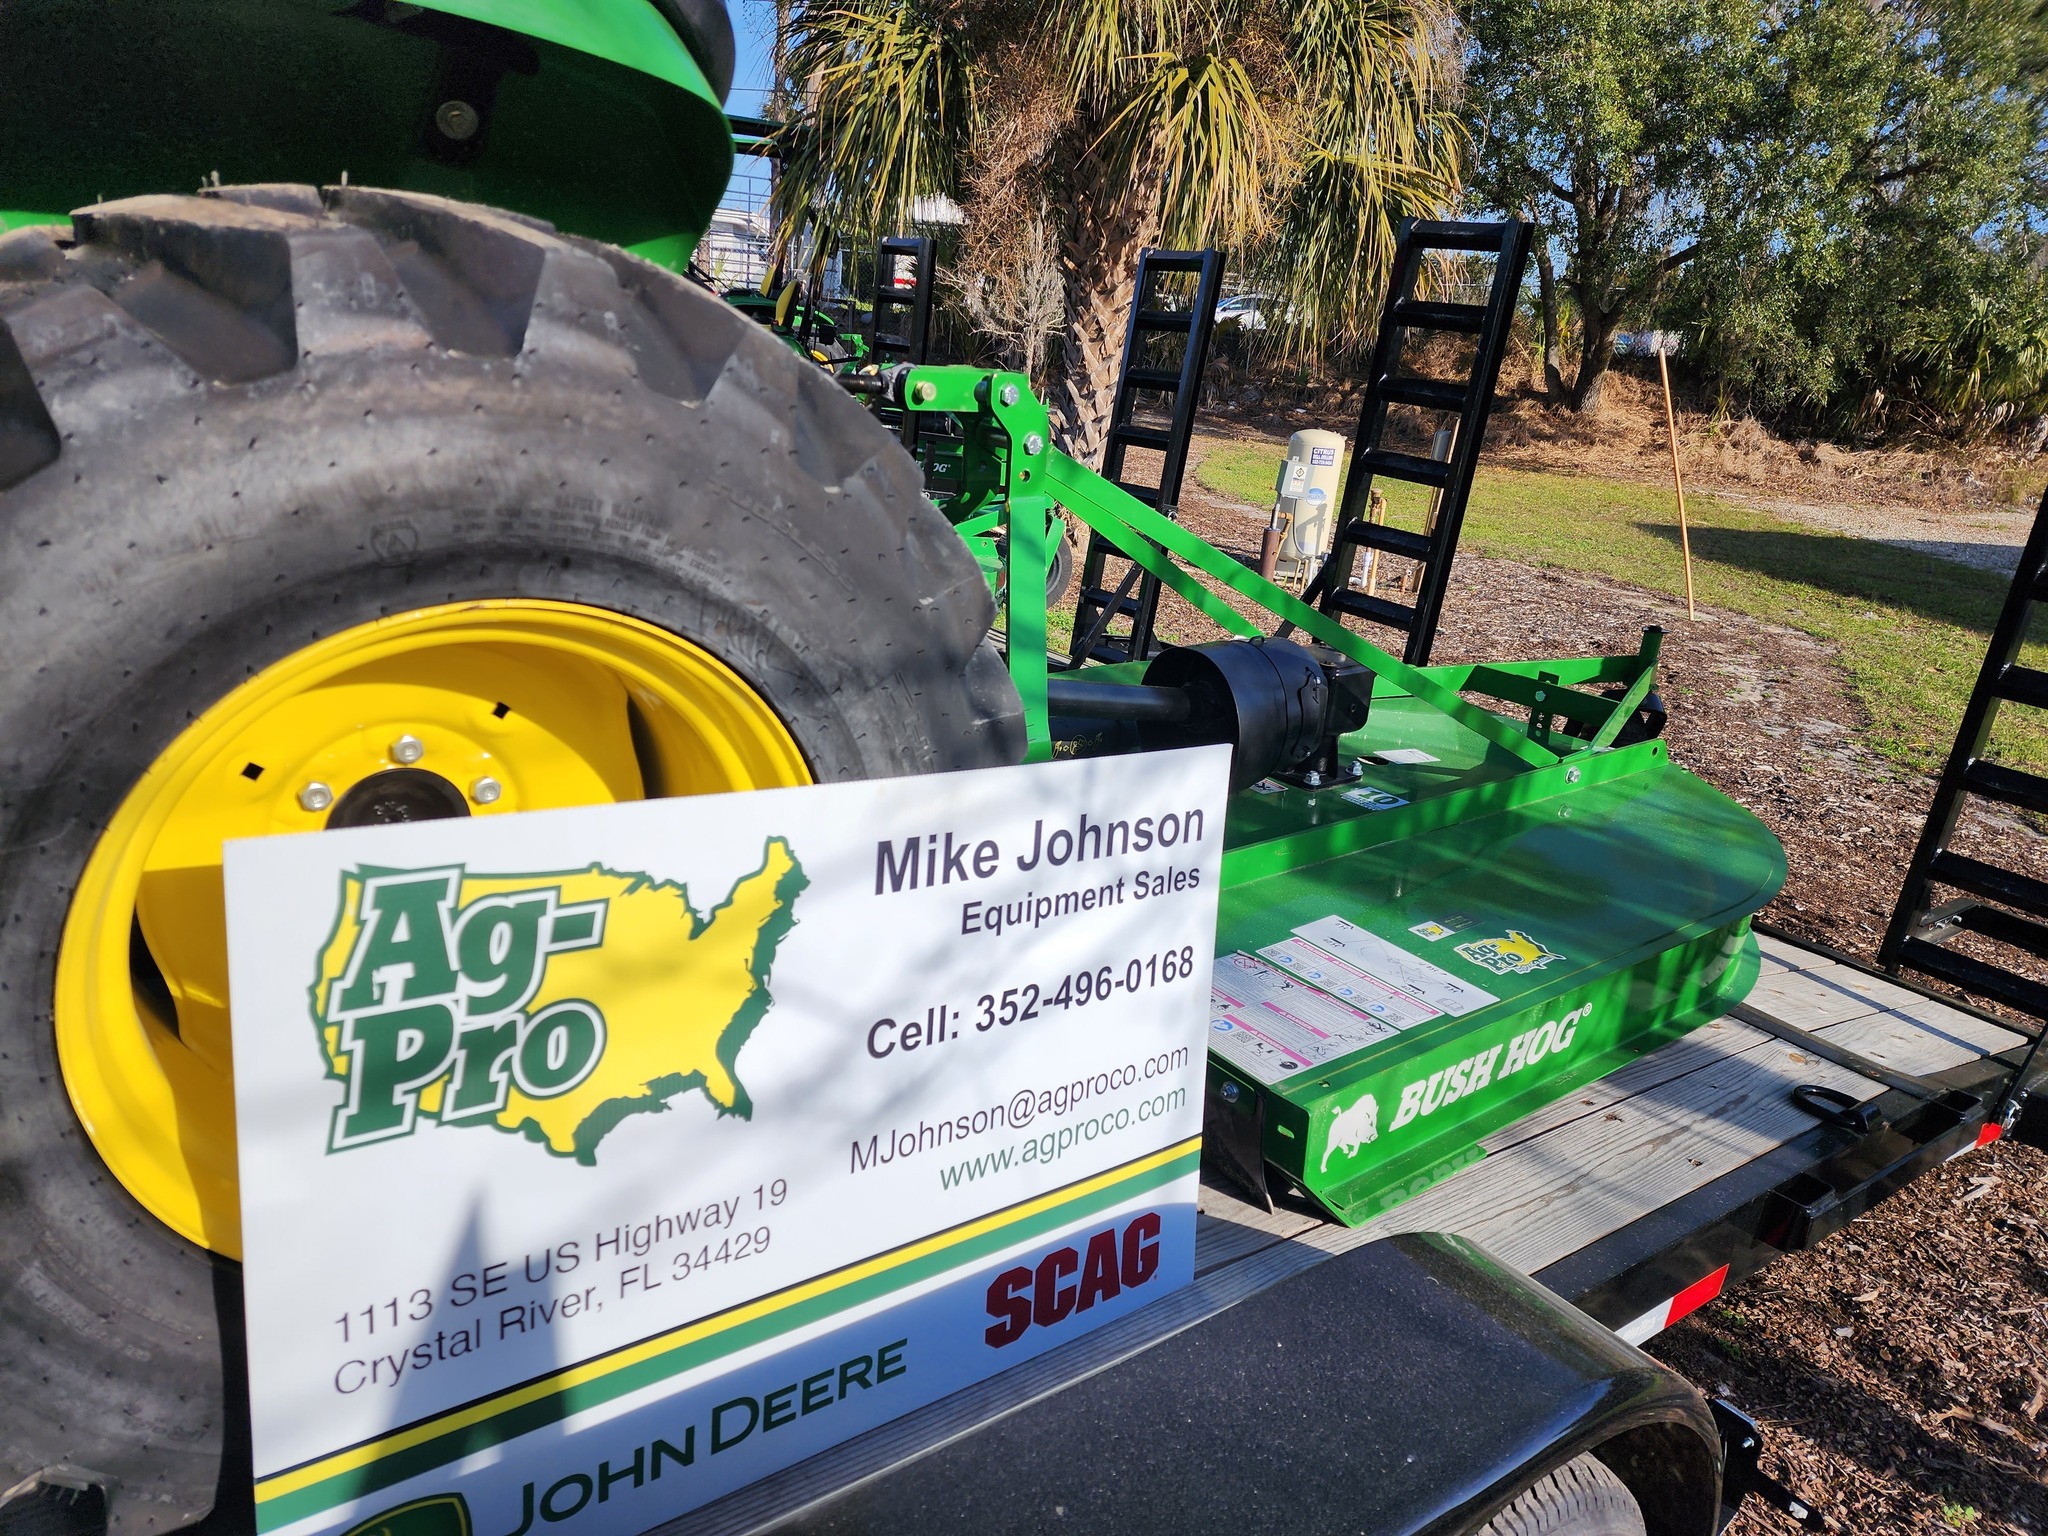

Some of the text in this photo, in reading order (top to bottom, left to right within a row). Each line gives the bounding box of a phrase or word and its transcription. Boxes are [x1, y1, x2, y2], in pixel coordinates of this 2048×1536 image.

[874, 808, 1203, 896] Mike Johnson
[1358, 791, 1400, 804] 10
[331, 865, 608, 1019] Ag-
[961, 866, 1200, 936] Equipment Sales
[867, 1005, 960, 1059] Cell:
[975, 945, 1194, 1032] 352-496-0168
[328, 998, 606, 1153] Pro
[850, 1045, 1189, 1174] MJohnson@agproco.com
[939, 1085, 1187, 1191] www.agproco.com
[1389, 1044, 1503, 1131] BUSH
[333, 1226, 771, 1396] Crystal River, FL 34429
[334, 1179, 789, 1344] 1113 SE US Highway 19
[985, 1213, 1162, 1350] SCAG
[507, 1338, 908, 1536] JOHN DEERE
